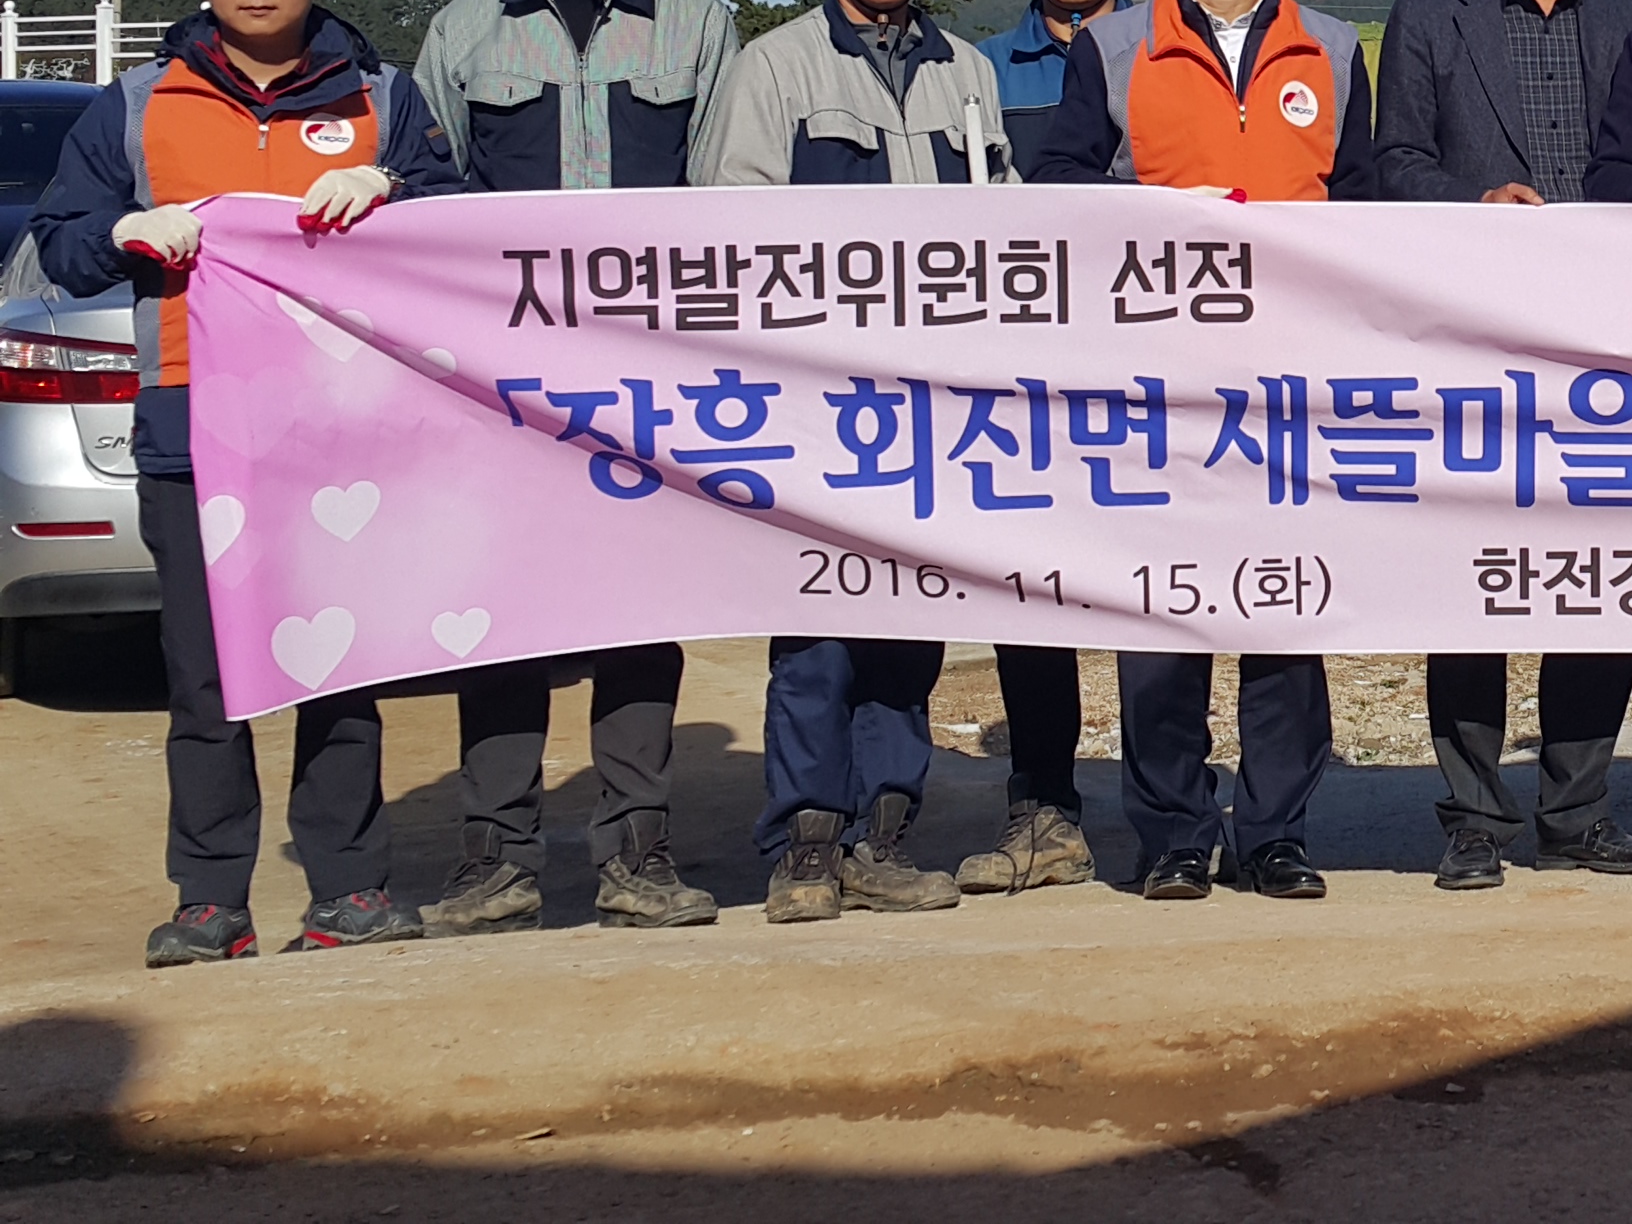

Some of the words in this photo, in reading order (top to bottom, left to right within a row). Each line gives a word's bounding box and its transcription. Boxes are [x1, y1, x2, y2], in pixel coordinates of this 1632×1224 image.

[502, 239, 1069, 331] 지역발전위원회
[1110, 240, 1255, 324] 선정
[823, 376, 1171, 519] 회진면
[799, 549, 966, 600] 2016.
[1004, 570, 1091, 610] 11.
